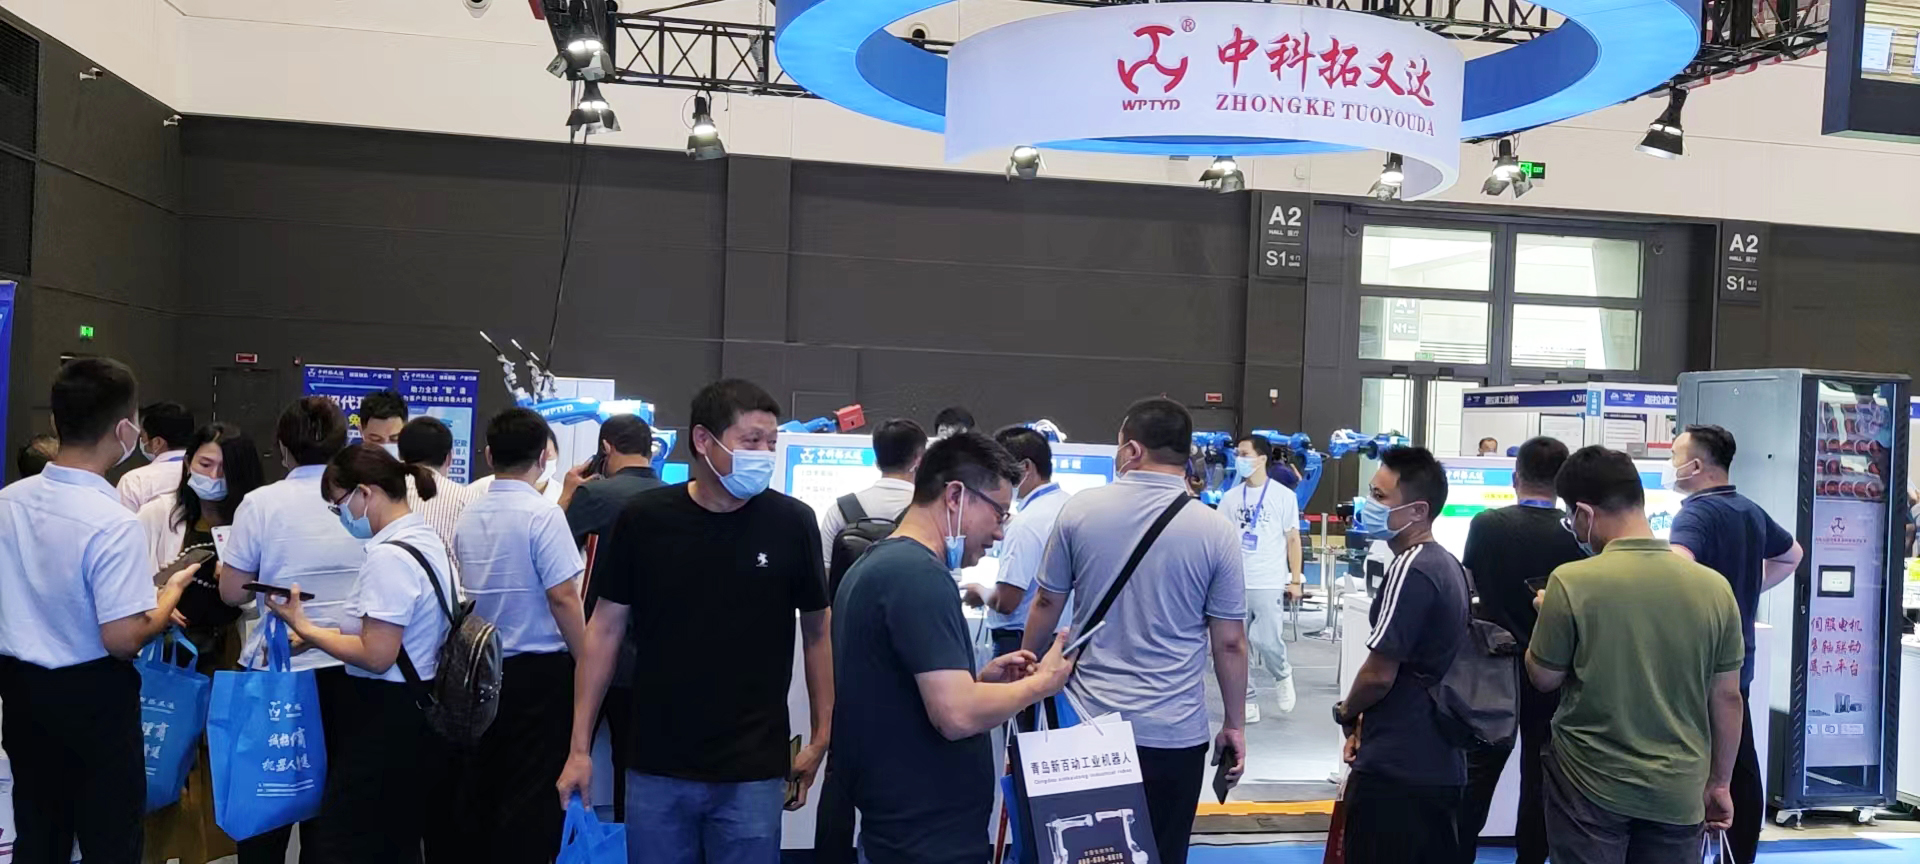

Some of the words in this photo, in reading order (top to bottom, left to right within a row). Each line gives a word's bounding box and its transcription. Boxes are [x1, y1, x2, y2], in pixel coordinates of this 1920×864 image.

[1217, 25, 1435, 107] 中科拓又达
[1122, 100, 1181, 111] WPTYD
[1216, 94, 1336, 118] ZHONGKE
[1342, 102, 1435, 137] TUOYOUDA
[1268, 205, 1302, 227] A2
[1729, 233, 1759, 254] A2
[1266, 250, 1286, 267] S1
[1726, 275, 1745, 291] S1
[1392, 322, 1407, 335] N1
[541, 403, 574, 417] WPTYD
[1811, 616, 1863, 633] 伺服电机
